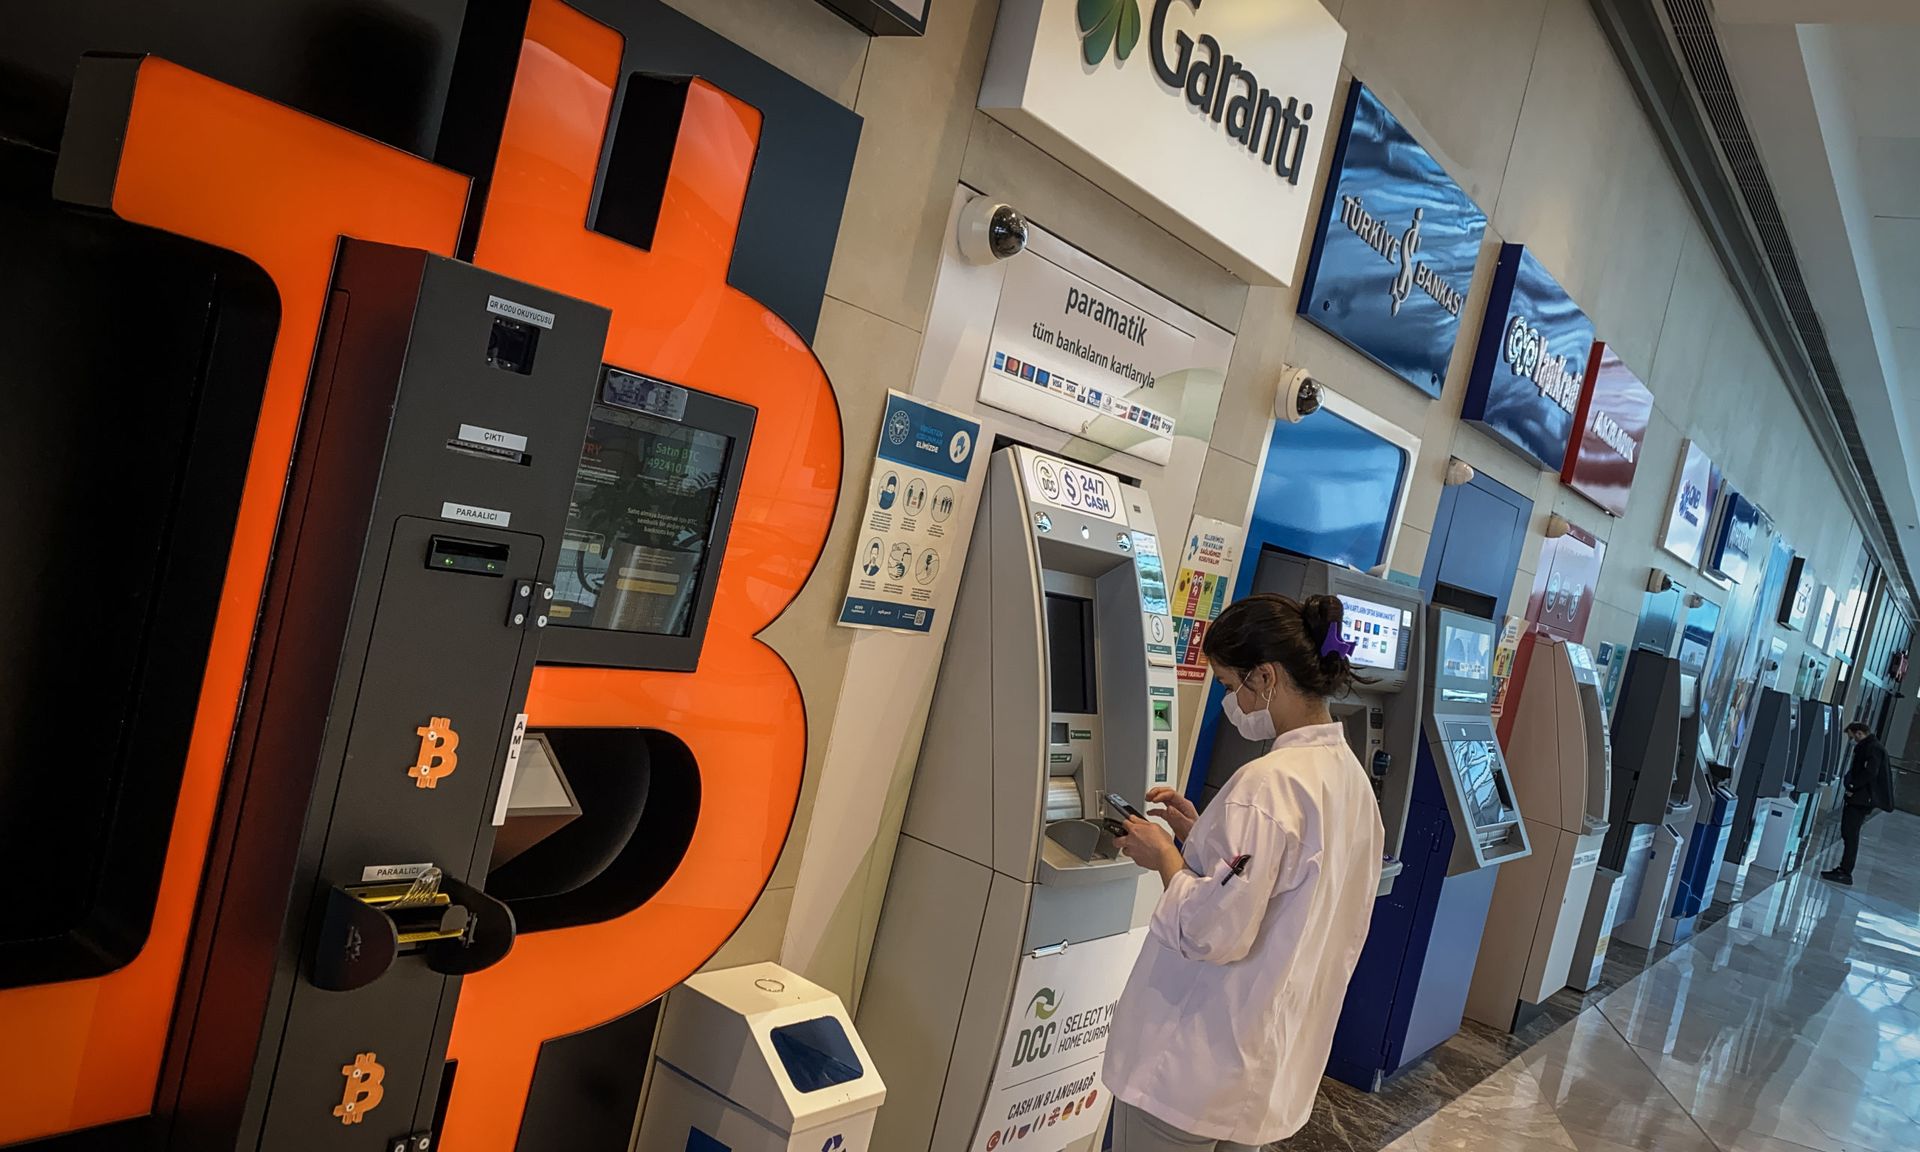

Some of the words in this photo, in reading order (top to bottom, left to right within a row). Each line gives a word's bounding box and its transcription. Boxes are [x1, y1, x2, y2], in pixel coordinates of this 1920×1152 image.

[1150, 0, 1314, 186] Garanti
[1341, 193, 1401, 265] TÜRKİYE
[1413, 260, 1464, 318] BANKASI
[489, 299, 499, 310] QR
[499, 303, 517, 314] KODU
[517, 308, 553, 326] OKUYUCUSU
[1064, 287, 1148, 347] paramatik
[1032, 321, 1054, 345] tüm
[1055, 330, 1109, 369] bankaların
[1109, 355, 1155, 390] kartlarıyla
[1591, 410, 1637, 464] AKBANK
[1080, 475, 1104, 496] 24/7
[1084, 493, 1110, 513] CASH
[1063, 1006, 1104, 1034] SELECT
[1011, 1021, 1057, 1068] DCC
[1058, 1033, 1084, 1054] HOME
[1007, 1097, 1034, 1120] CASH
[1032, 1093, 1045, 1111] IN
[1043, 1091, 1052, 1107] 8
